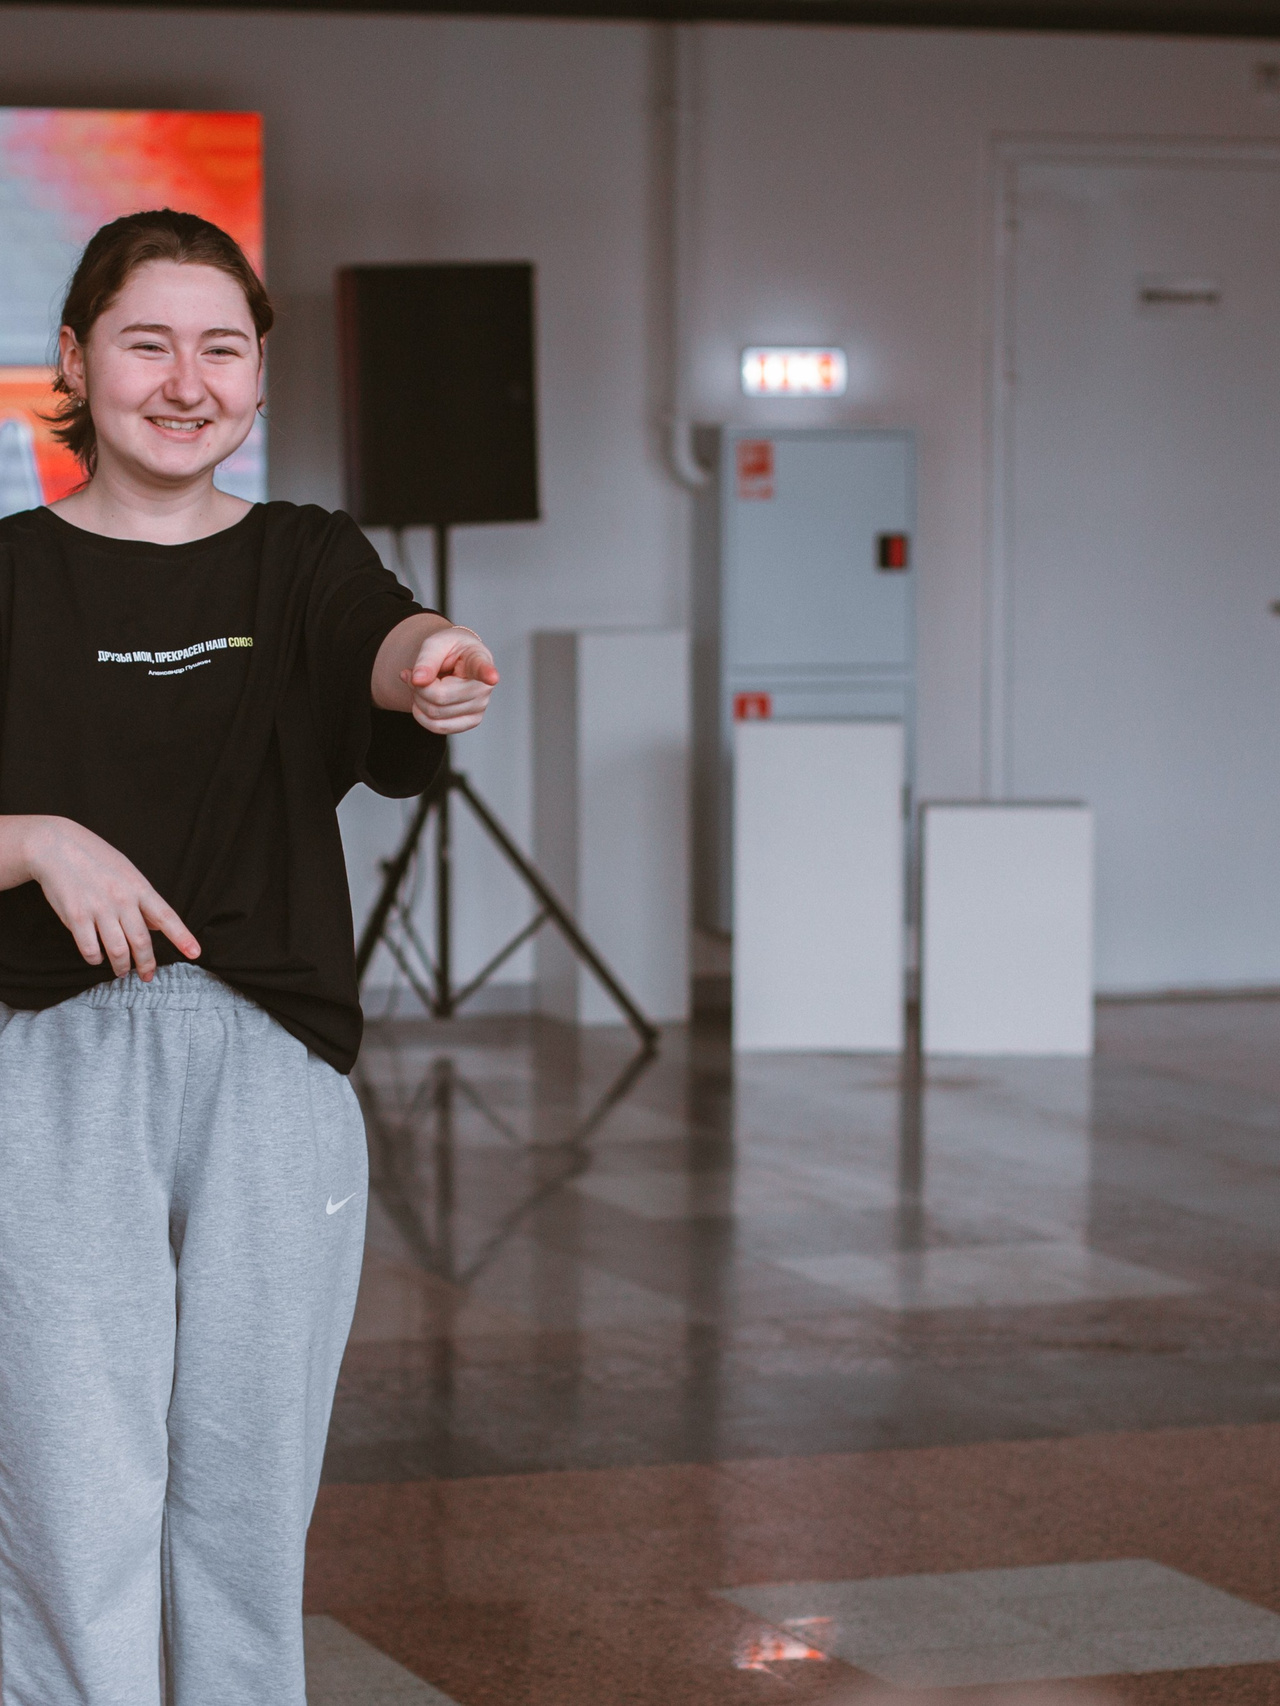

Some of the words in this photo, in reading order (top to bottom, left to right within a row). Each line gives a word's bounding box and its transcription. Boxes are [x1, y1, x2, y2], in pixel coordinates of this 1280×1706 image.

[97, 650, 132, 663] ДРУЗЬЯ
[154, 642, 205, 663] ПРЕКРАСЕН
[205, 637, 228, 651] НАШ
[228, 636, 254, 648] СОЮЗ
[148, 667, 186, 676] Александр
[185, 659, 212, 671] Пушкин
